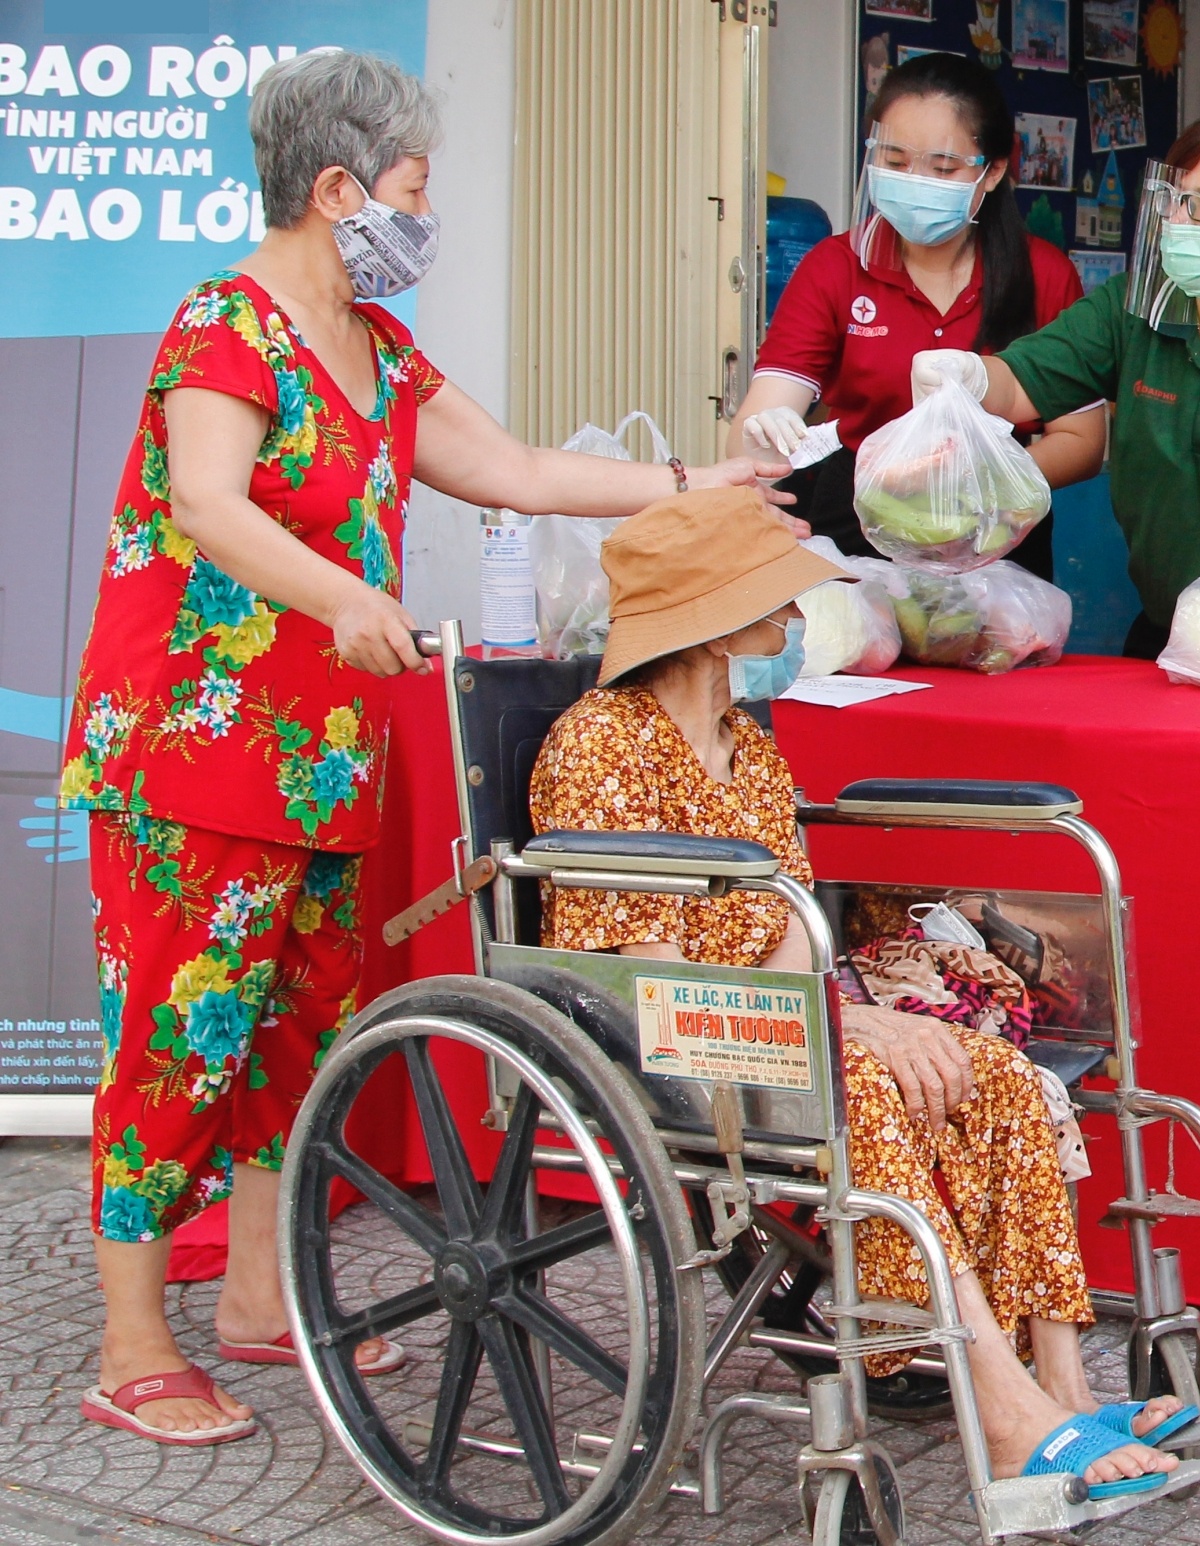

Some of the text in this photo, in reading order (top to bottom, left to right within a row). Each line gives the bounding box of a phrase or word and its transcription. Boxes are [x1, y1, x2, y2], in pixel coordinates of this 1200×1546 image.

[0, 35, 344, 111] BAO RỘN
[0, 102, 208, 140] ÌNH NGƯỜI
[29, 142, 213, 182] VIỆT NAM
[0, 187, 143, 242] BAO
[364, 228, 411, 277] SUBSCRIBING
[674, 986, 690, 1004] XE
[725, 991, 742, 1009] XE
[746, 990, 772, 1012] LĂN
[776, 995, 802, 1014] TAY
[17, 1018, 67, 1034] nhưng
[69, 1018, 101, 1032] tình
[726, 1013, 806, 1048] TƯỜNG
[1, 1039, 15, 1049] và
[17, 1037, 45, 1051] phát
[75, 1038, 90, 1049] ăn
[1, 1055, 30, 1067] thiếu
[34, 1056, 51, 1067] xin
[53, 1055, 76, 1067] đến
[690, 1059, 707, 1068] 50A
[767, 1057, 779, 1065] GIA
[780, 1058, 790, 1066] VN
[84, 1076, 104, 1087] qu
